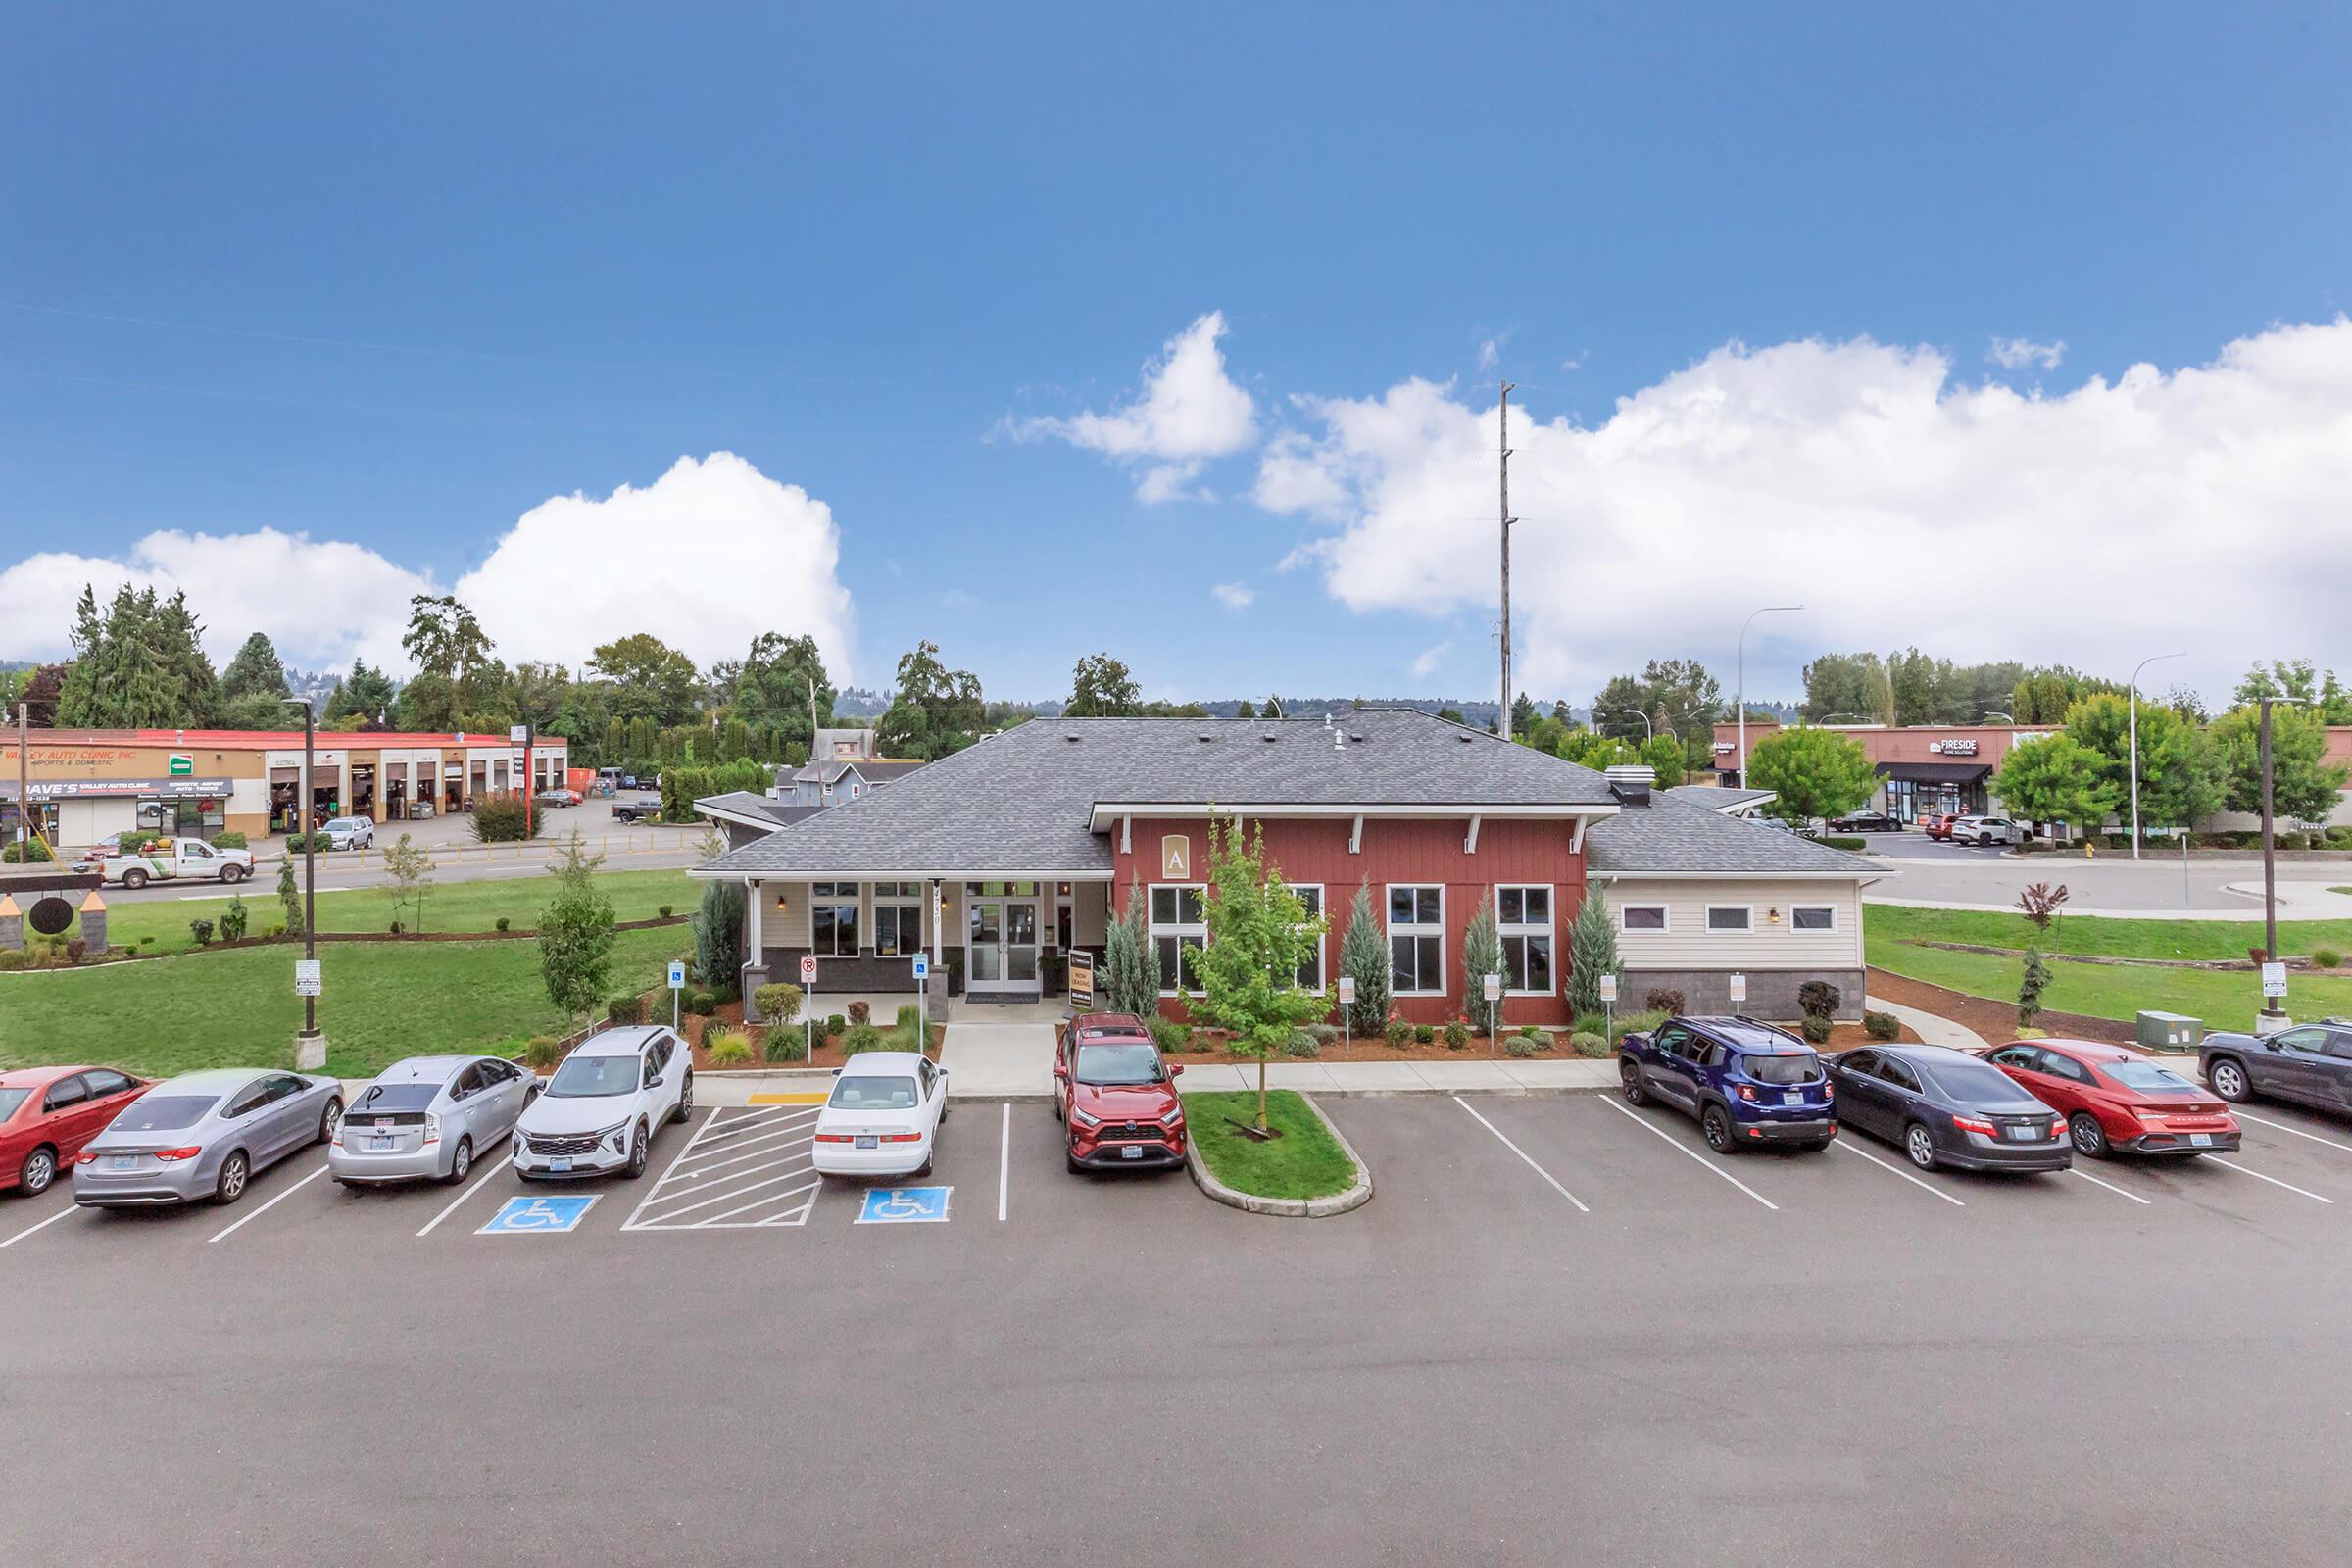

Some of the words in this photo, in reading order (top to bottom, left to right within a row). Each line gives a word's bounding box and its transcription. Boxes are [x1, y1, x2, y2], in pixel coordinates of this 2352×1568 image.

[1941, 739, 1977, 750] FIRESIDE
[6, 751, 44, 760] VAEY
[48, 751, 77, 760] AUTO
[80, 751, 115, 760] CLINIC
[1168, 850, 1185, 869] A
